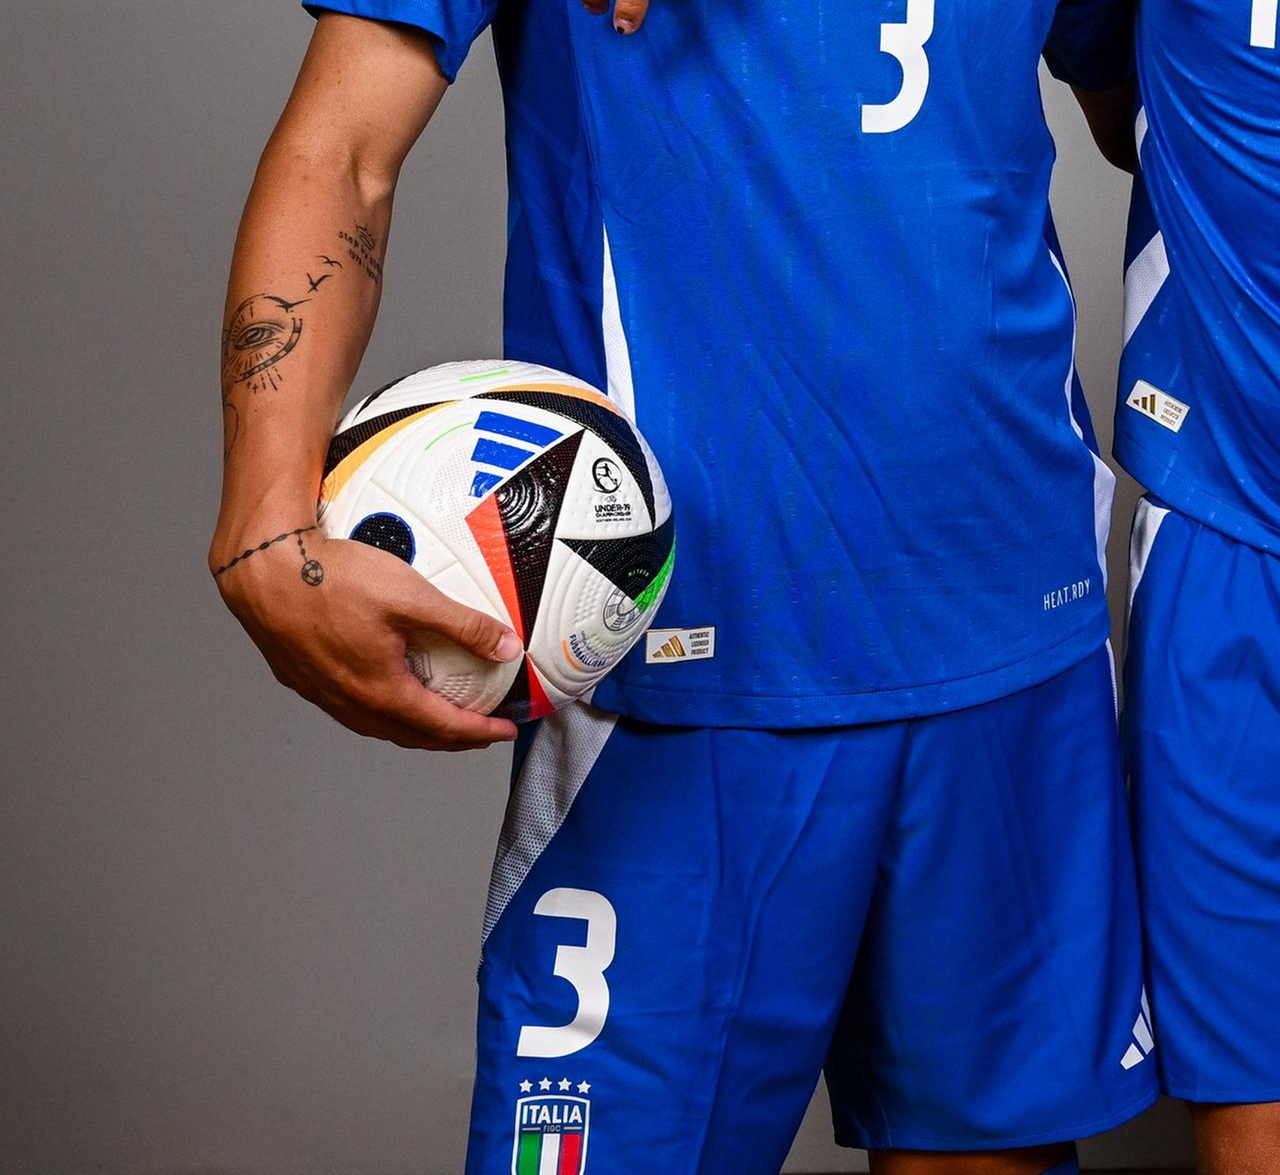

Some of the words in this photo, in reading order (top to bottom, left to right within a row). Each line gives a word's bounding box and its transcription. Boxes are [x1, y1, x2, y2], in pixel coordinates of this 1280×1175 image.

[1043, 578, 1090, 611] HEAT.RDY
[517, 888, 616, 1057] 3
[522, 1104, 583, 1125] ITALIA
[543, 1124, 562, 1133] FIGC
